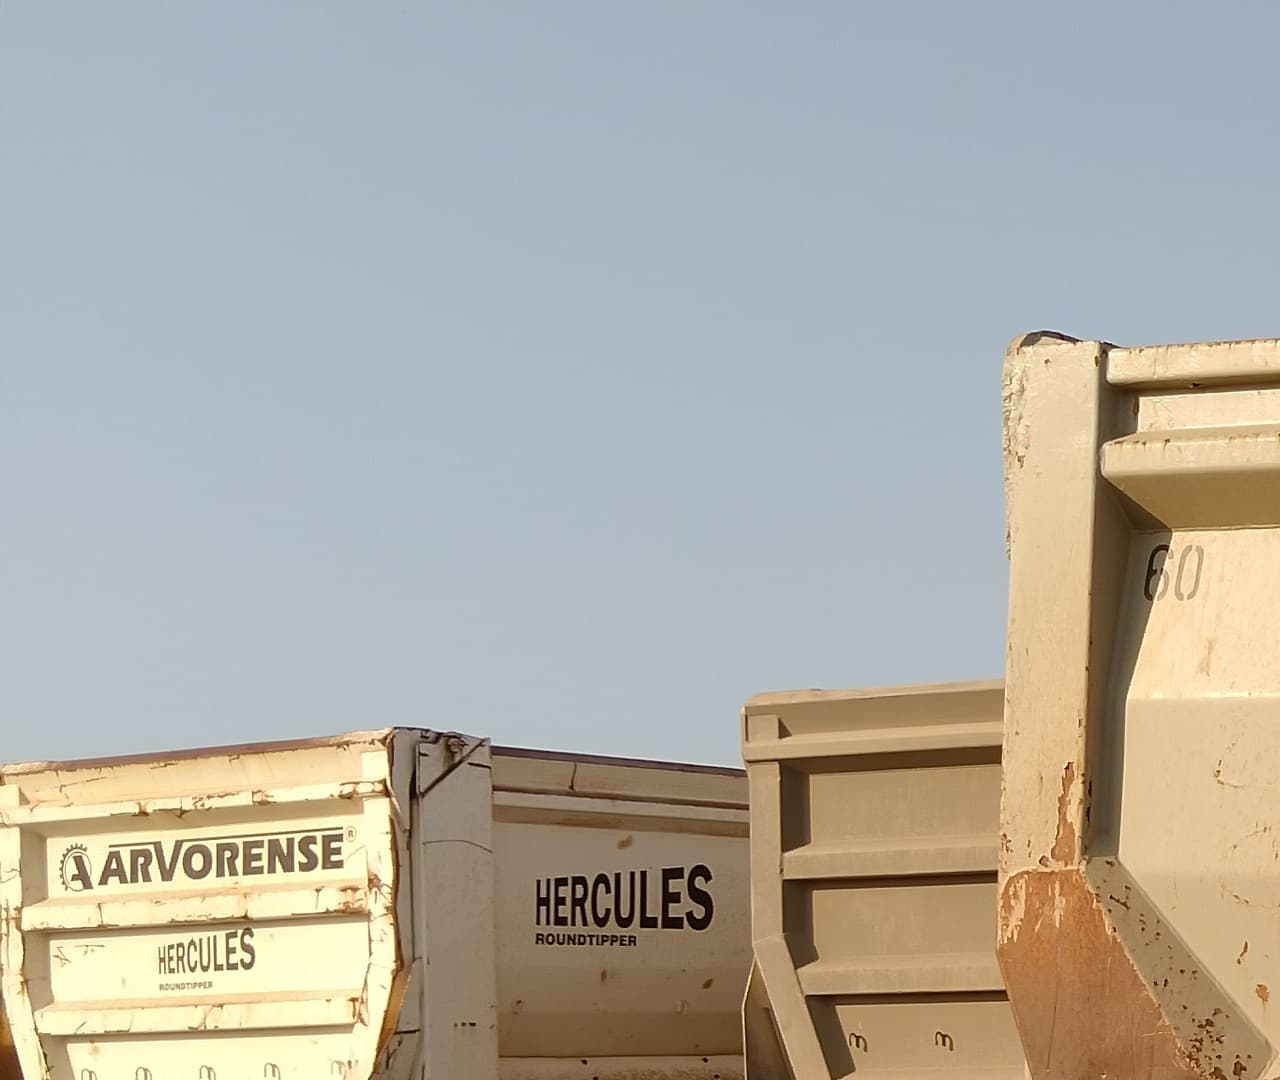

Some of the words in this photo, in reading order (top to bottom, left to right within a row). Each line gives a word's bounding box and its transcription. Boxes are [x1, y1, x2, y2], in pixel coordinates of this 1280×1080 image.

[1143, 543, 1205, 602] 60
[97, 829, 345, 887] ARVORENSE
[535, 864, 714, 931] HERCULES
[157, 927, 256, 975] HERCULES
[535, 933, 637, 947] ROUNDTIPPER
[158, 980, 213, 992] ROUNDTIPPER
